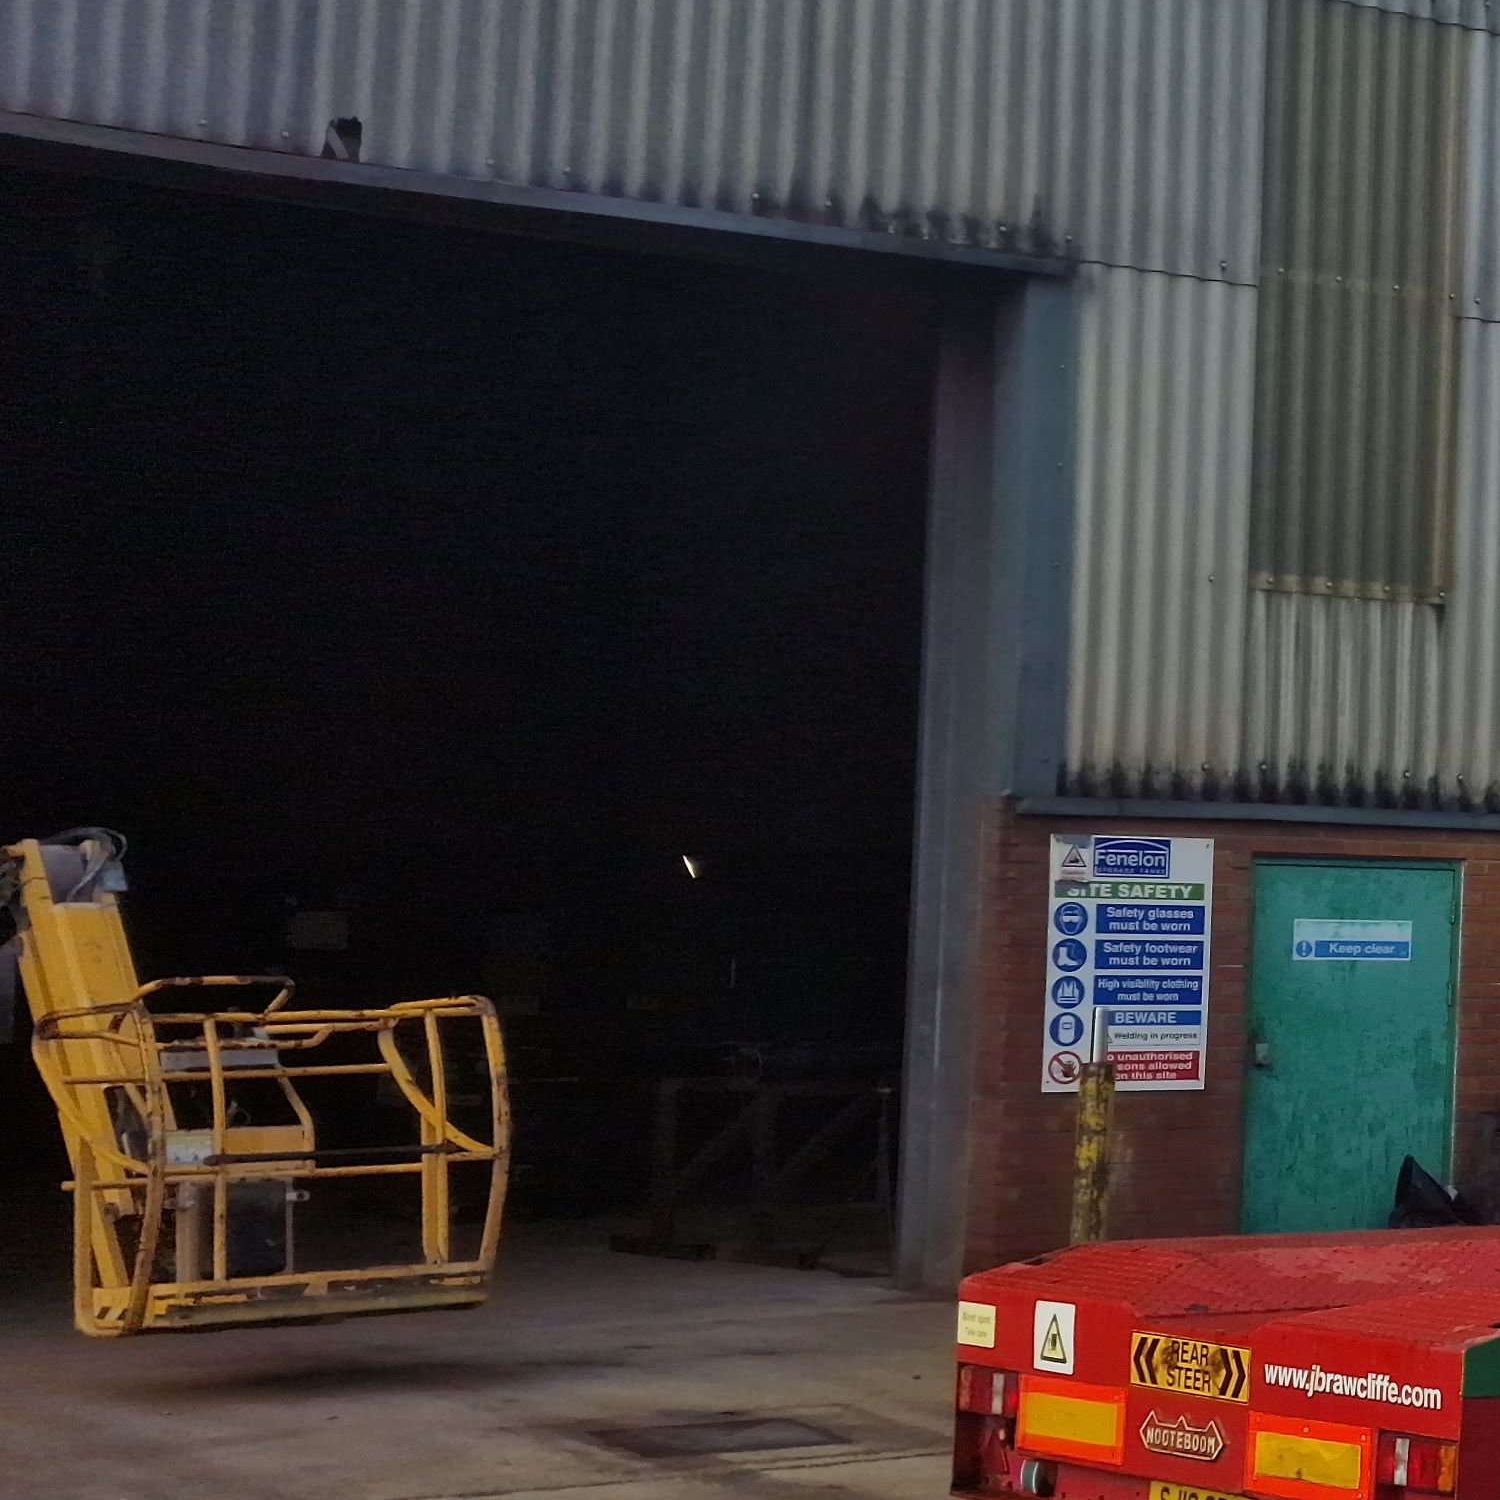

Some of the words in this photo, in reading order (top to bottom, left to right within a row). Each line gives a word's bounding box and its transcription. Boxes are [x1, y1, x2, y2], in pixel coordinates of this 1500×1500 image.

[1095, 850, 1165, 867] Fenelon
[1118, 884, 1192, 899] SAFETY
[1107, 907, 1146, 920] Safety
[1148, 908, 1194, 920] glasses
[1109, 921, 1140, 931] must
[1143, 921, 1158, 931] be
[1161, 922, 1190, 931] worn
[1103, 942, 1142, 955] Safety
[1145, 942, 1198, 954] footwear
[1329, 943, 1361, 955] Keep
[1364, 943, 1396, 954] clear
[1109, 956, 1140, 966] must
[1143, 956, 1158, 965] be
[1161, 957, 1191, 966] worn
[1098, 979, 1120, 991] High
[1122, 979, 1159, 990] visibility
[1162, 979, 1199, 991] clothing
[1117, 992, 1141, 1000] must
[1143, 992, 1155, 1000] be
[1115, 1011, 1177, 1024] BEWARE
[1114, 1032, 1148, 1041] Welding
[1160, 1033, 1198, 1041] progress
[1118, 1052, 1193, 1061] unauthorised
[1148, 1061, 1191, 1070] allowed
[1132, 1071, 1153, 1080] this
[1156, 1071, 1177, 1079] site
[1170, 1340, 1209, 1367] REAR
[1166, 1367, 1212, 1392] STEER
[1264, 1363, 1442, 1410] www.jbrawcliffe.com
[1146, 1427, 1216, 1454] NOOTEBOOM
